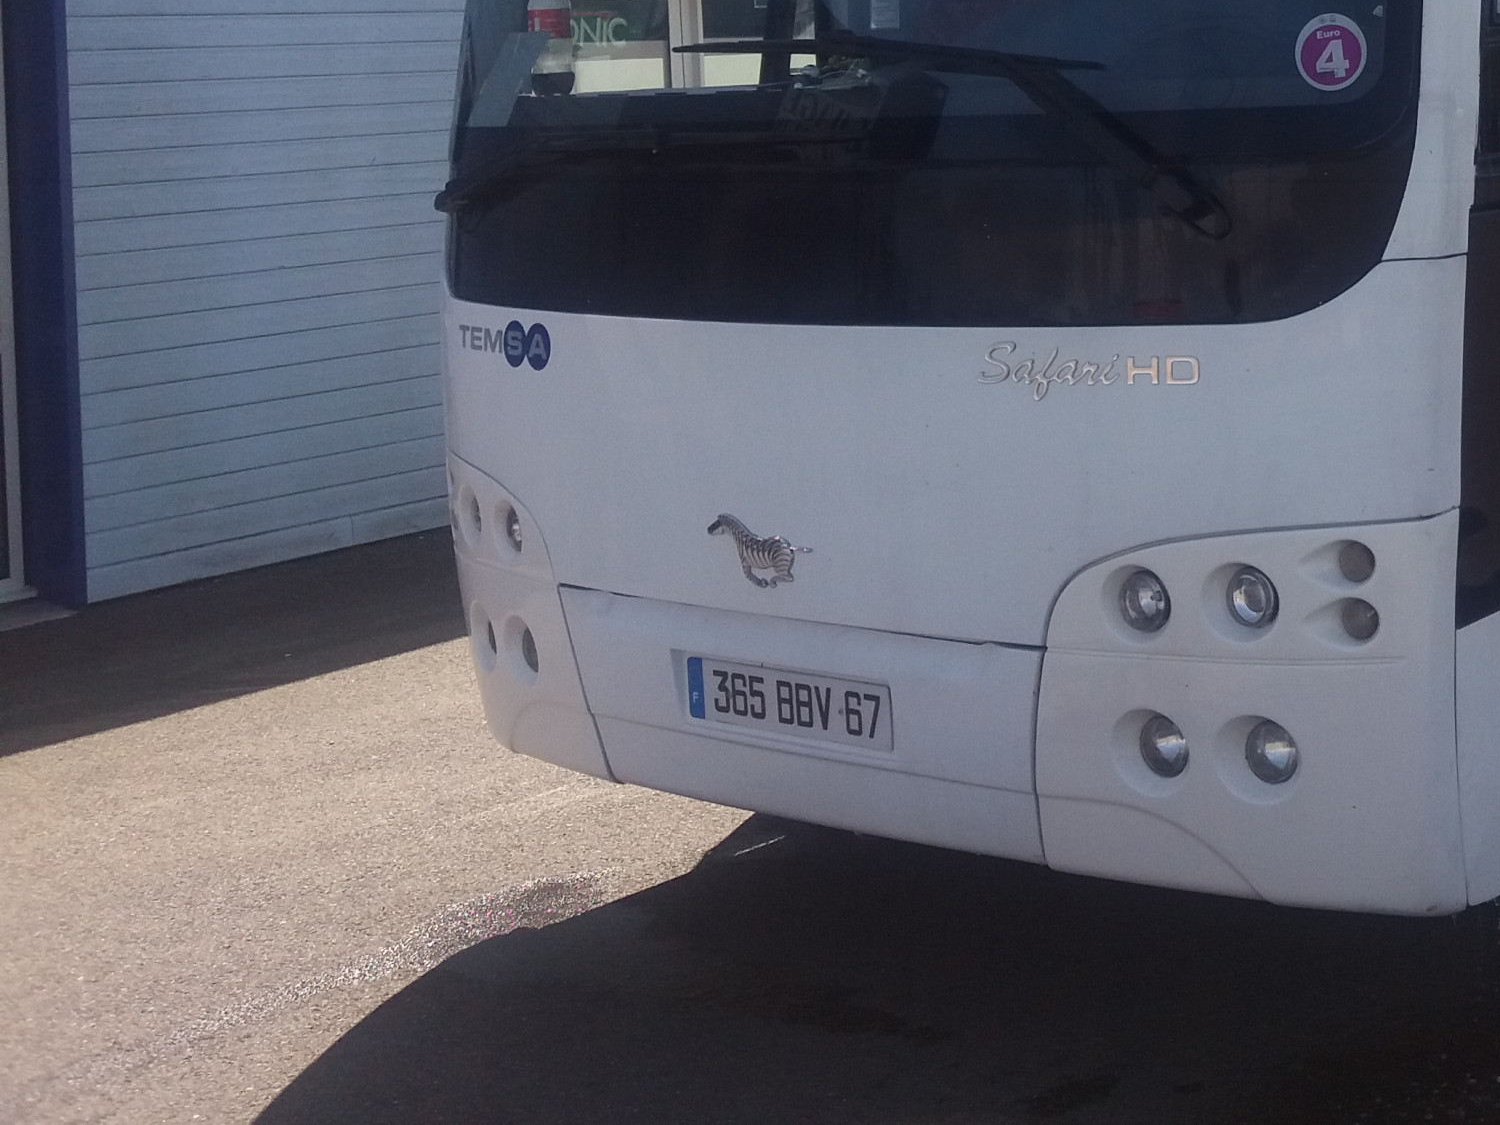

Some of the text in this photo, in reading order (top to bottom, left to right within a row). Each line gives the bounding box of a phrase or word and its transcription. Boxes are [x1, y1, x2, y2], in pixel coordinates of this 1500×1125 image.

[1316, 29, 1341, 40] Euro
[1315, 38, 1350, 79] 4
[712, 669, 881, 739] 365 BBV 67
